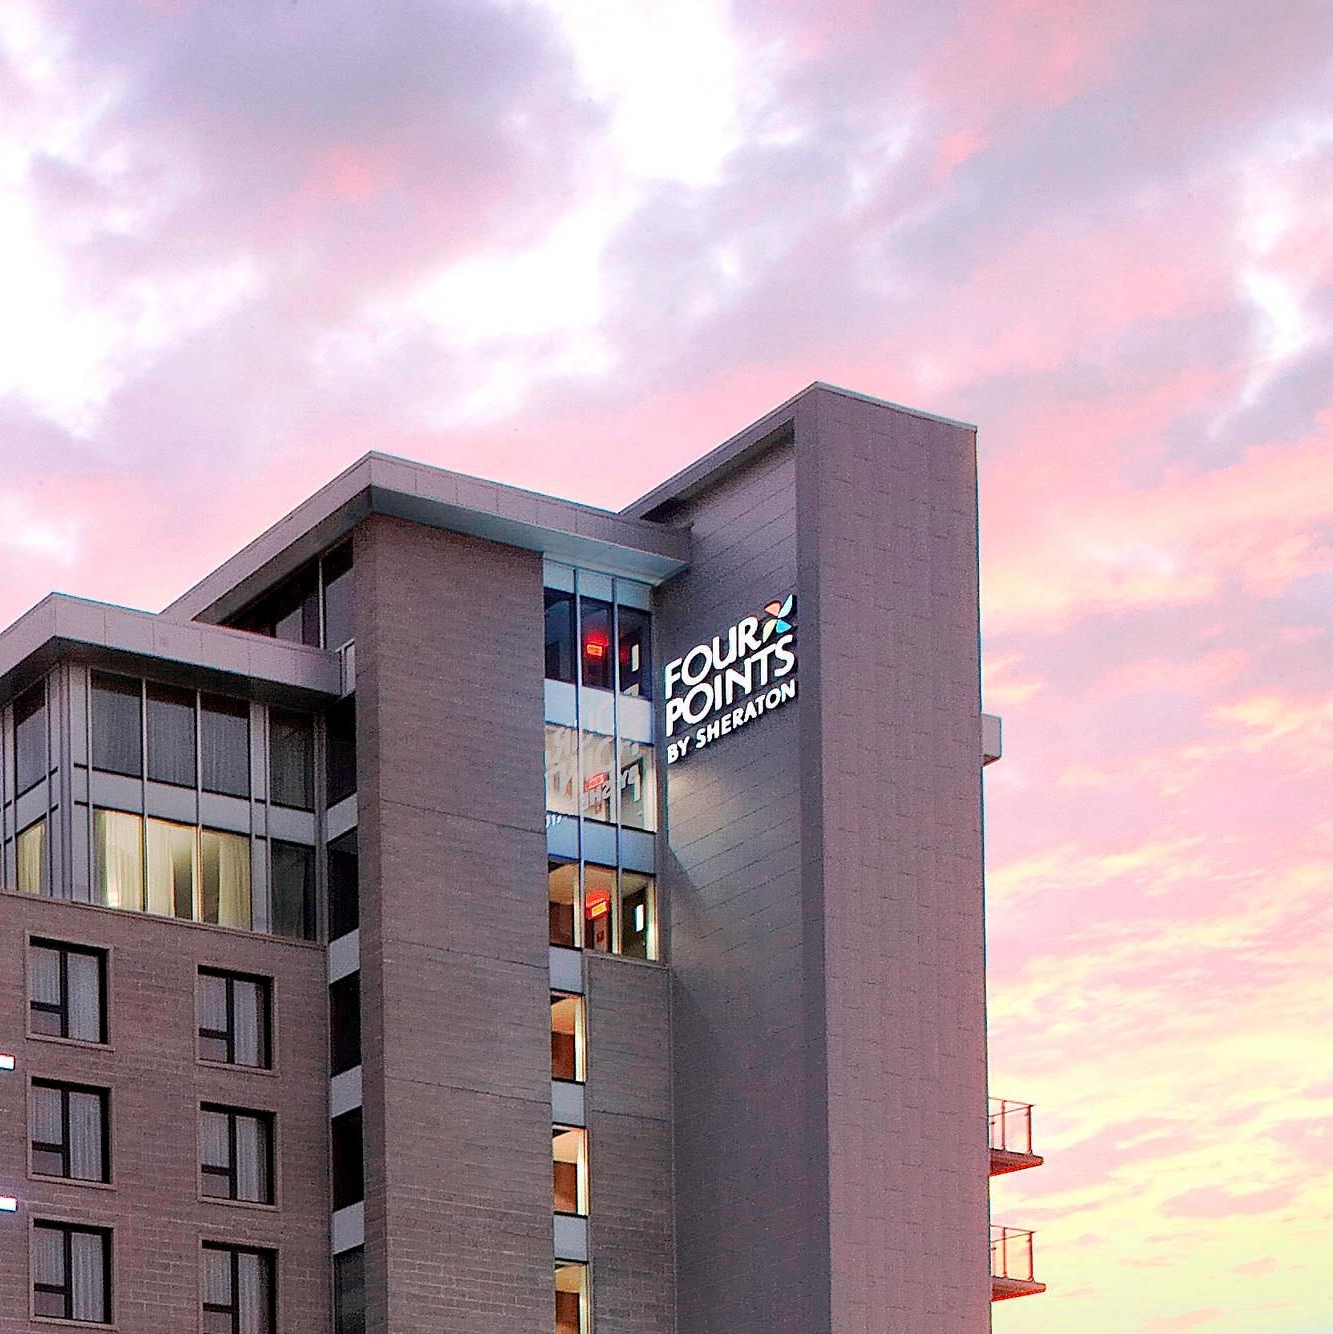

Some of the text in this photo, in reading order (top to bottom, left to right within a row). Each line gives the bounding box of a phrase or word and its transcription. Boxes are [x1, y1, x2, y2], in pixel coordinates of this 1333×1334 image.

[665, 615, 761, 699] FOUR
[666, 634, 795, 737] POINTS
[667, 678, 796, 764] BY SHERATON
